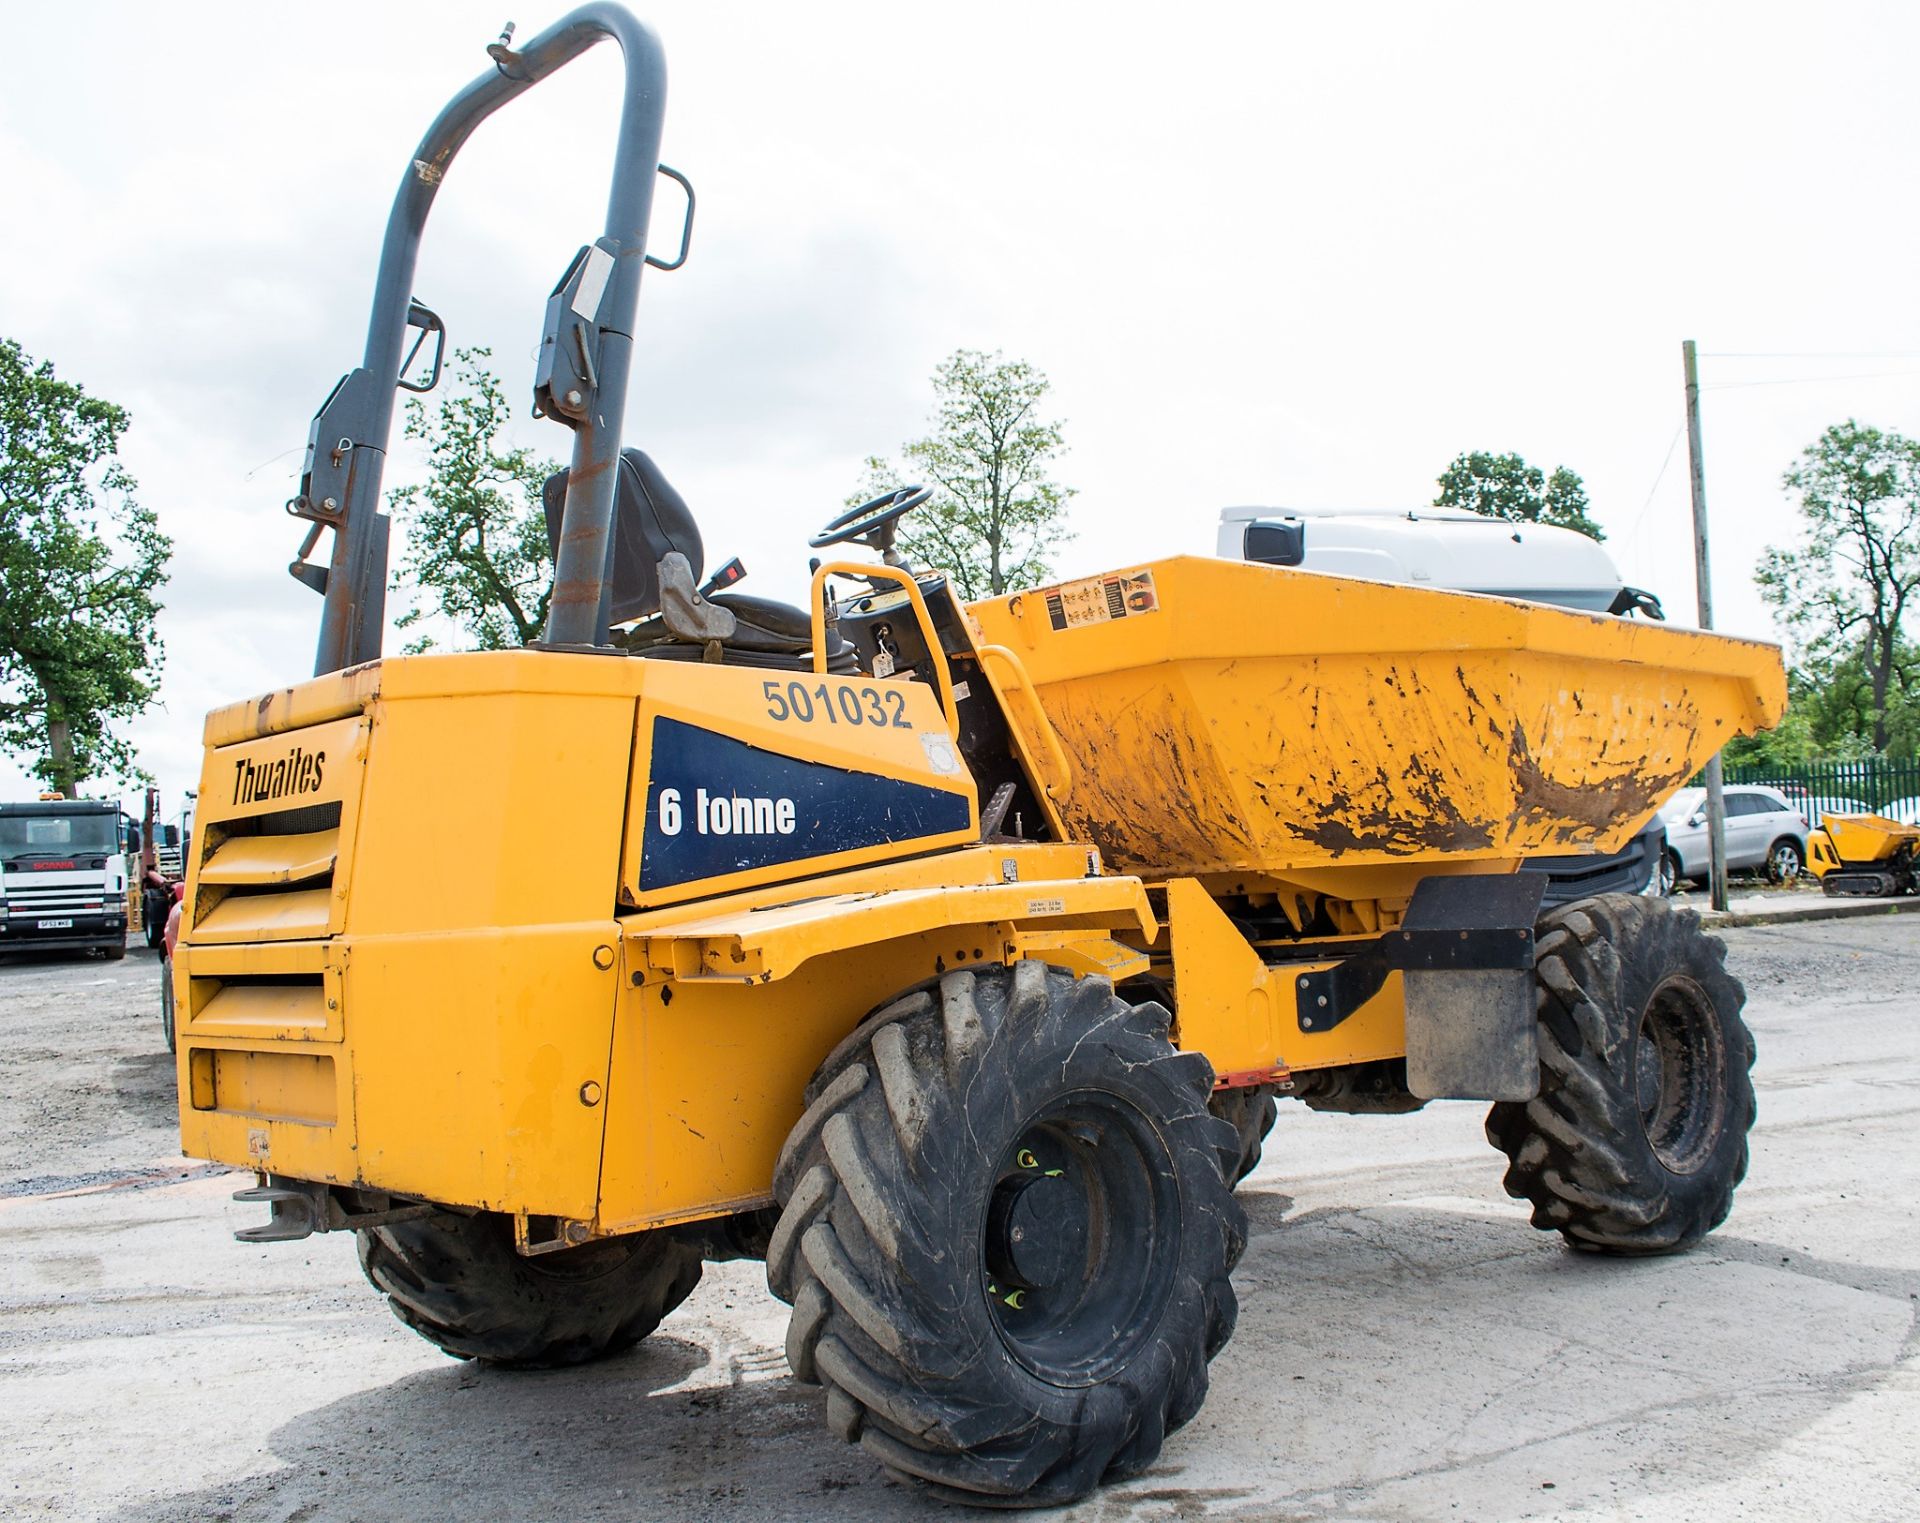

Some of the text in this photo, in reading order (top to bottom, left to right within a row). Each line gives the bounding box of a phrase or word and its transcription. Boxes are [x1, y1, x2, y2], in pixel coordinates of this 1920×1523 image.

[763, 681, 913, 729] 501032
[232, 747, 326, 806] Thwaites
[659, 788, 796, 836] 6 tonne
[33, 861, 76, 870] SCANIA
